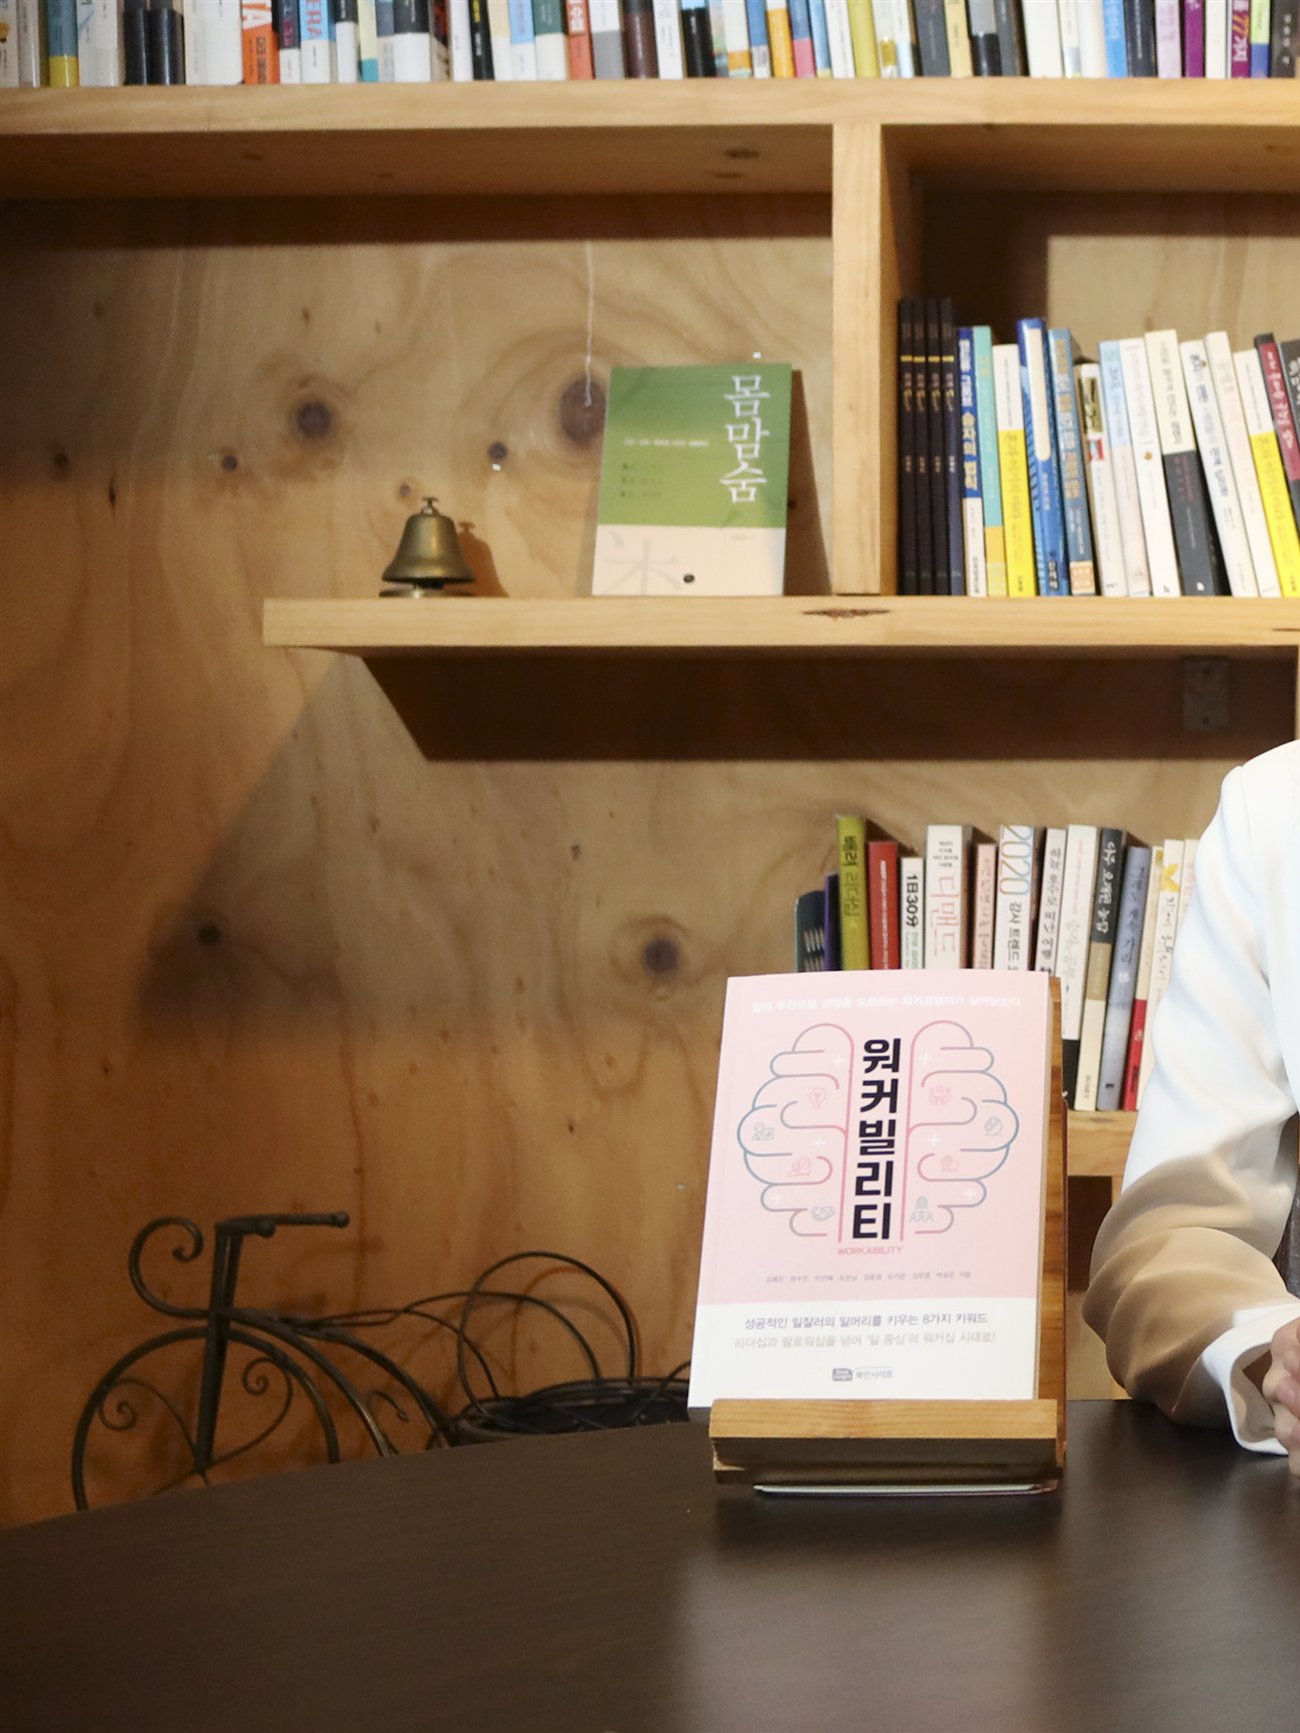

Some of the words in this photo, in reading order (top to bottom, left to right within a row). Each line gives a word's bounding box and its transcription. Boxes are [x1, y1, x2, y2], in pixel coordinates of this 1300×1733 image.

[720, 374, 770, 504] 몸맘숨
[843, 835, 859, 867] 배려
[1000, 825, 1033, 895] 2020
[845, 871, 861, 919] 리더십
[905, 875, 919, 927] 1日30分
[930, 876, 960, 952] 디맨드
[1009, 902, 1022, 924] 강사
[1008, 928, 1021, 961] 트렌드
[852, 1037, 902, 1240] 워커빌리티
[837, 1245, 904, 1256] WORKABILITY
[734, 1336, 778, 1349] 리더십과
[782, 1334, 836, 1348] 팔로워십을
[840, 1334, 862, 1346] 넘어
[923, 1331, 955, 1344] 워커십
[959, 1331, 997, 1343] 시대로!
[744, 1316, 788, 1330] 성공적인
[792, 1315, 835, 1328] 일잘러의
[839, 1314, 882, 1327] 일머리를
[887, 1313, 919, 1326] 키우는
[922, 1313, 951, 1325] 8가지
[955, 1312, 989, 1324] 키워드
